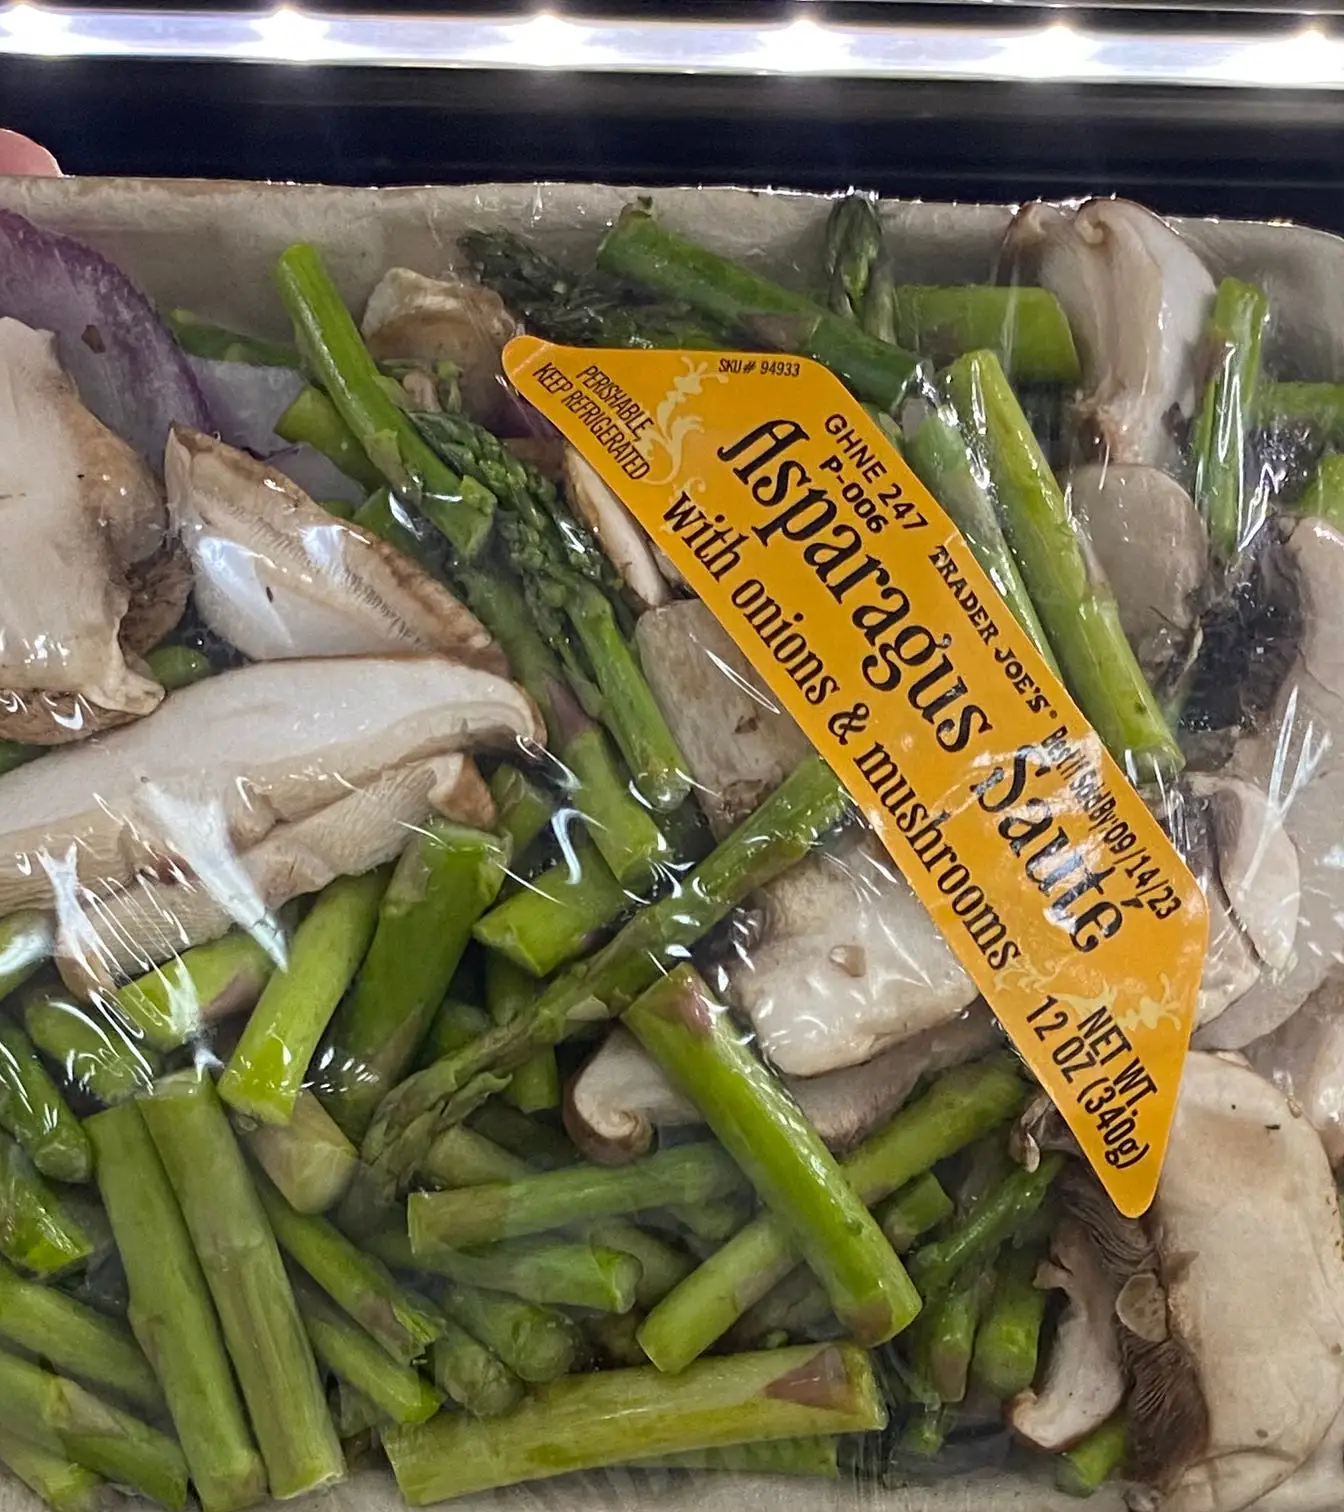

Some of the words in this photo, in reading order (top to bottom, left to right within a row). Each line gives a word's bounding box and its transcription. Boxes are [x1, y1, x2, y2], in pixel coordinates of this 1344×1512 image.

[532, 361, 573, 396] KEEP
[561, 386, 652, 480] REFRIGERATED
[760, 360, 800, 377] 94933
[819, 455, 888, 534] P-006
[824, 413, 887, 484] GHNE
[877, 483, 928, 530] 247
[928, 544, 1000, 646] TRADER
[662, 491, 749, 583] with
[732, 577, 841, 704] onions
[829, 702, 870, 746] &
[852, 741, 1022, 970] mushrooms
[717, 418, 994, 753] Asparagus
[969, 743, 1144, 953] Sauté
[1025, 995, 1069, 1042] 12
[1051, 1035, 1097, 1084] OZ
[1076, 1076, 1151, 1170] (340g)
[1077, 1005, 1133, 1067] NET
[1112, 1057, 1158, 1117] WT.
